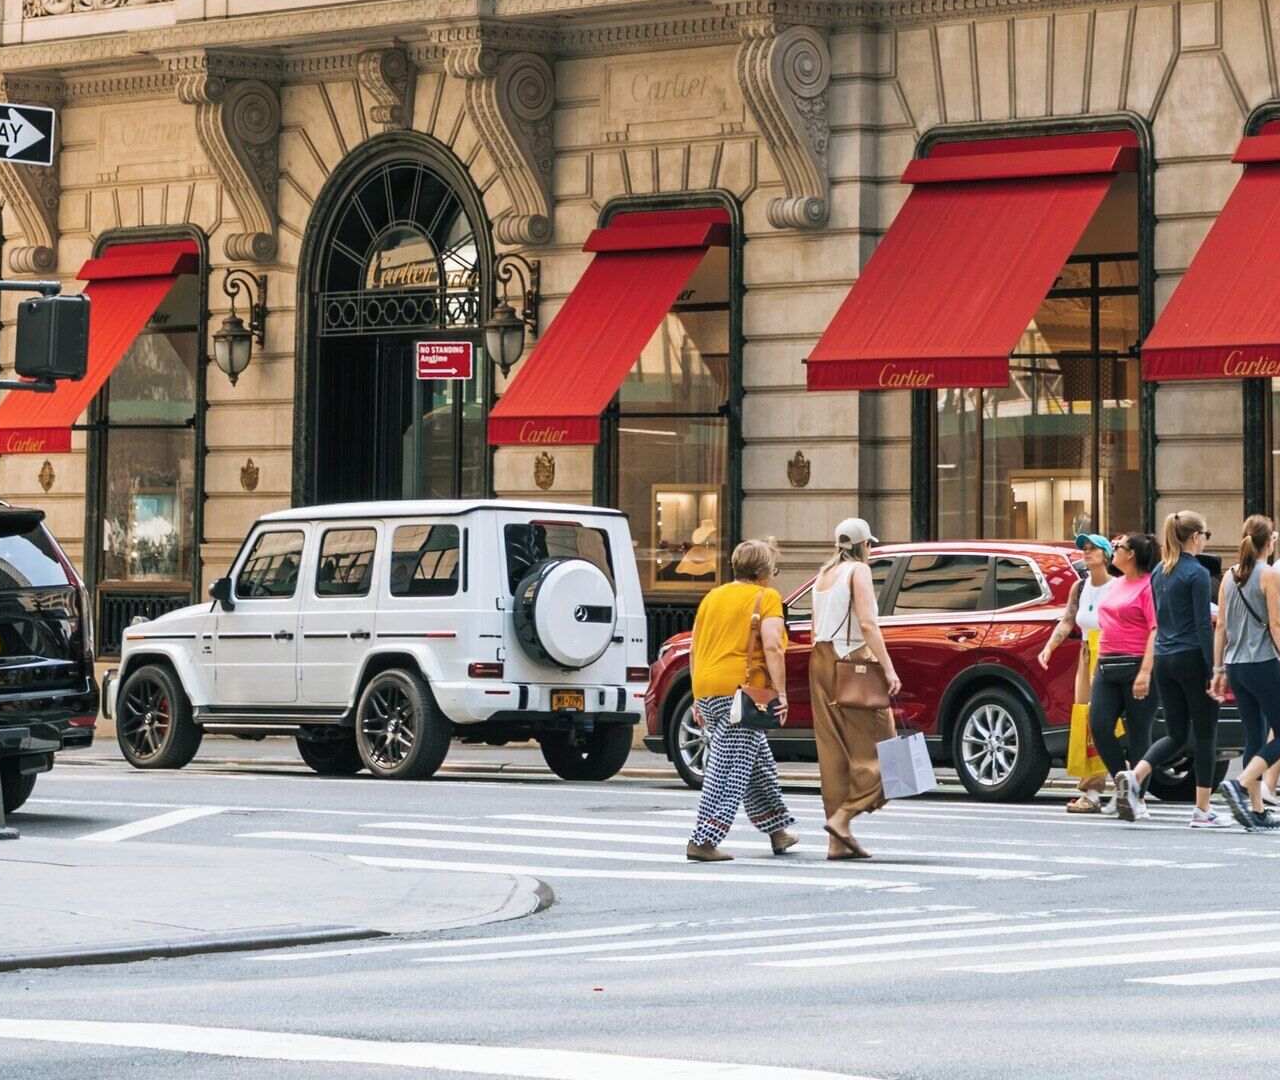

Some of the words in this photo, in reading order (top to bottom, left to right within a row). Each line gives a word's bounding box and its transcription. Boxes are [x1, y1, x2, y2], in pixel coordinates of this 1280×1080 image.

[631, 73, 712, 102] Cartier
[372, 257, 435, 286] Cartier
[420, 355, 448, 364] Anytime
[431, 346, 464, 354] STANDING
[879, 363, 934, 387] Cartier
[7, 431, 46, 452] Cartier
[519, 420, 568, 443] Cartier
